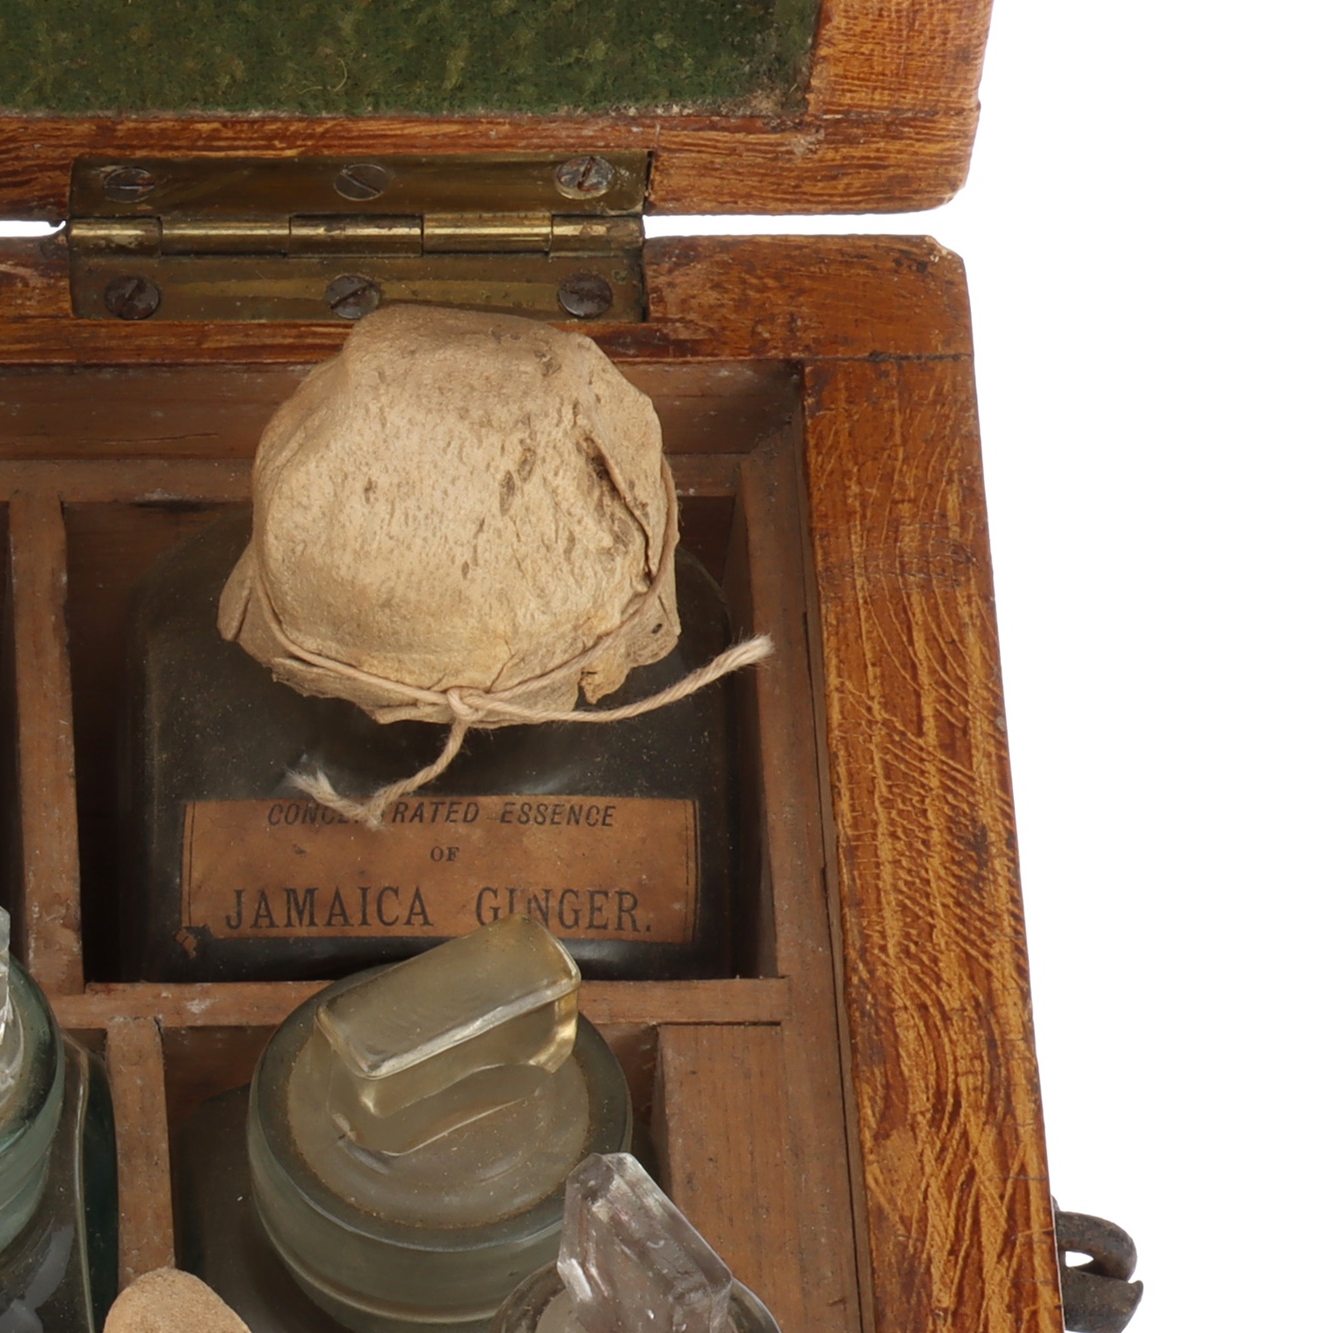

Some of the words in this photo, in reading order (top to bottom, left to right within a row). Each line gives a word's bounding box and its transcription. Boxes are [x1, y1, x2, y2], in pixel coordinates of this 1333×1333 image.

[267, 802, 480, 827] CONCRATED
[500, 802, 616, 827] ESSENCE
[430, 846, 460, 862] OF
[225, 886, 434, 930] JAMAICA
[475, 886, 652, 933] GINGER.
